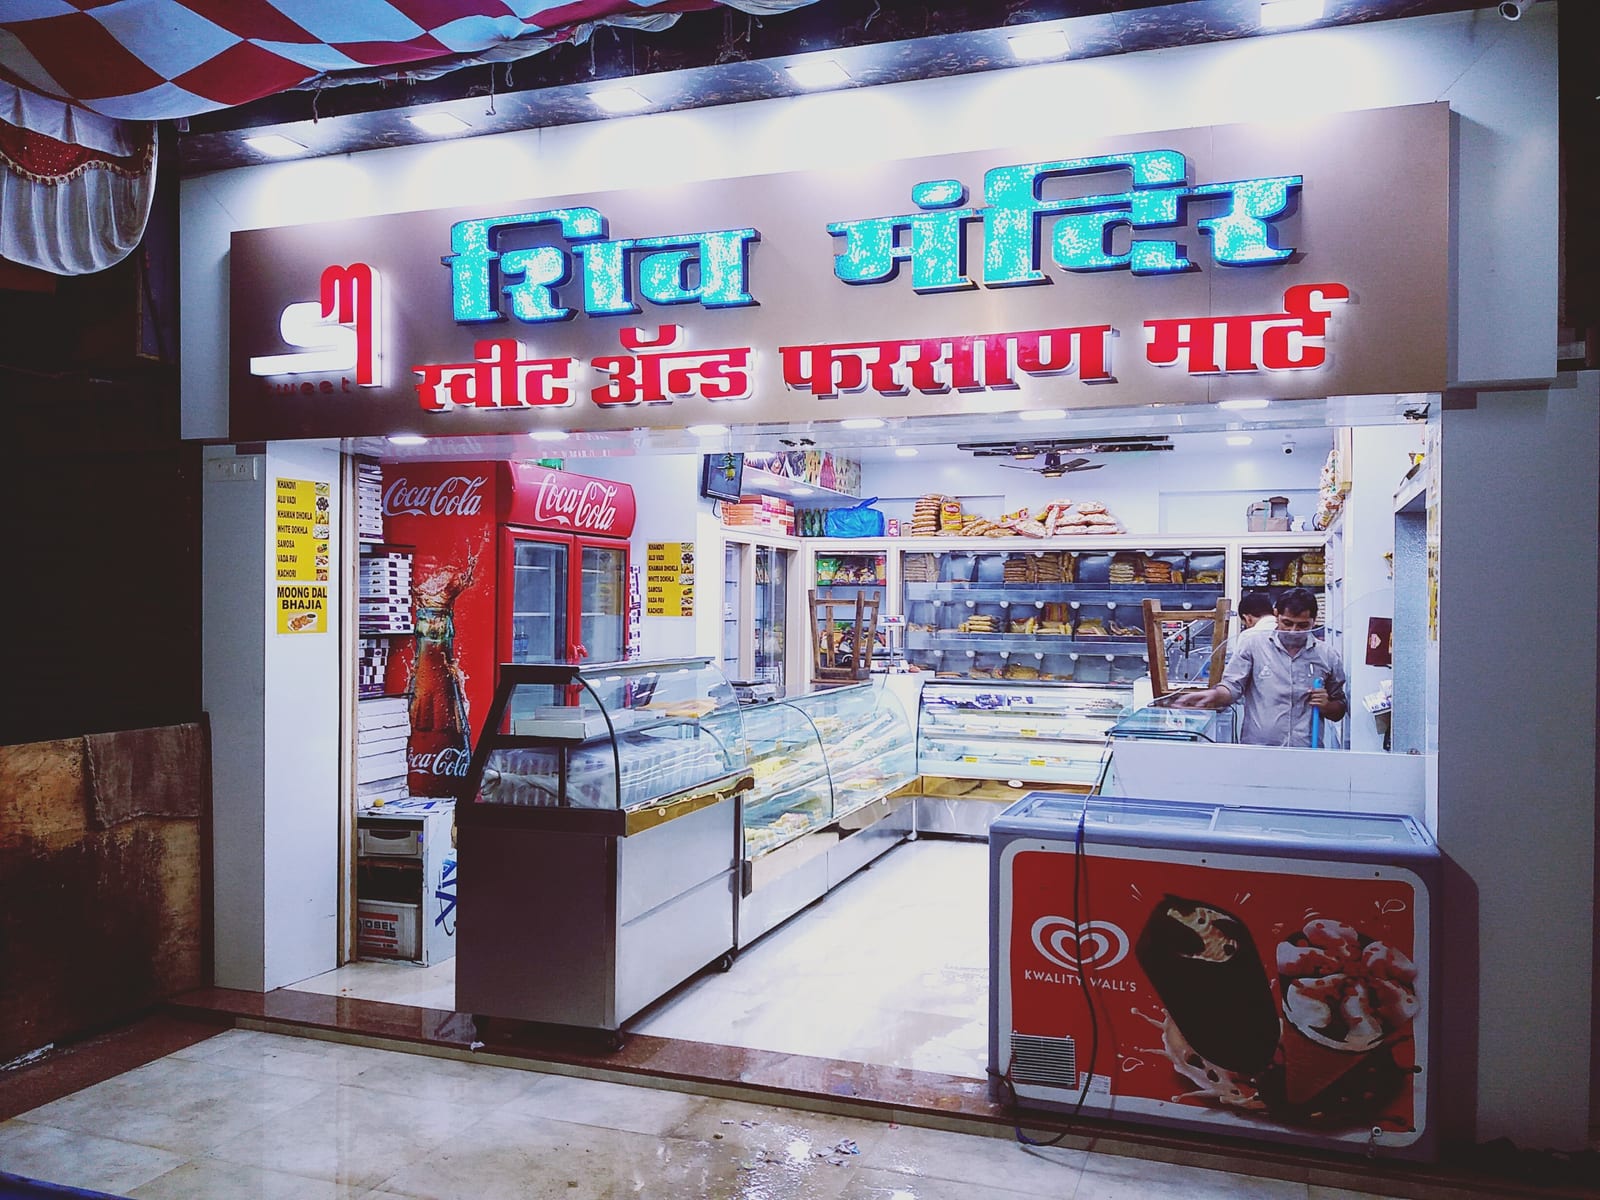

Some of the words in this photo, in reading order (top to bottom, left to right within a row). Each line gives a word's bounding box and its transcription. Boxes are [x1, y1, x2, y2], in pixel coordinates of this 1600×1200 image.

[442, 206, 760, 324] शिव
[826, 150, 1303, 293] मंदिर
[412, 339, 580, 412] स्वीट
[778, 324, 1118, 399] फरसाण
[1143, 283, 1350, 375] मार्ट
[383, 476, 488, 517] Coca-Cola
[535, 473, 618, 531] Coca-Cola
[277, 586, 310, 598] MOONG
[312, 587, 327, 598] DAL
[282, 599, 322, 610] BHAJIA
[1025, 969, 1082, 986] KWALITY
[1090, 977, 1137, 992] WALL'S
